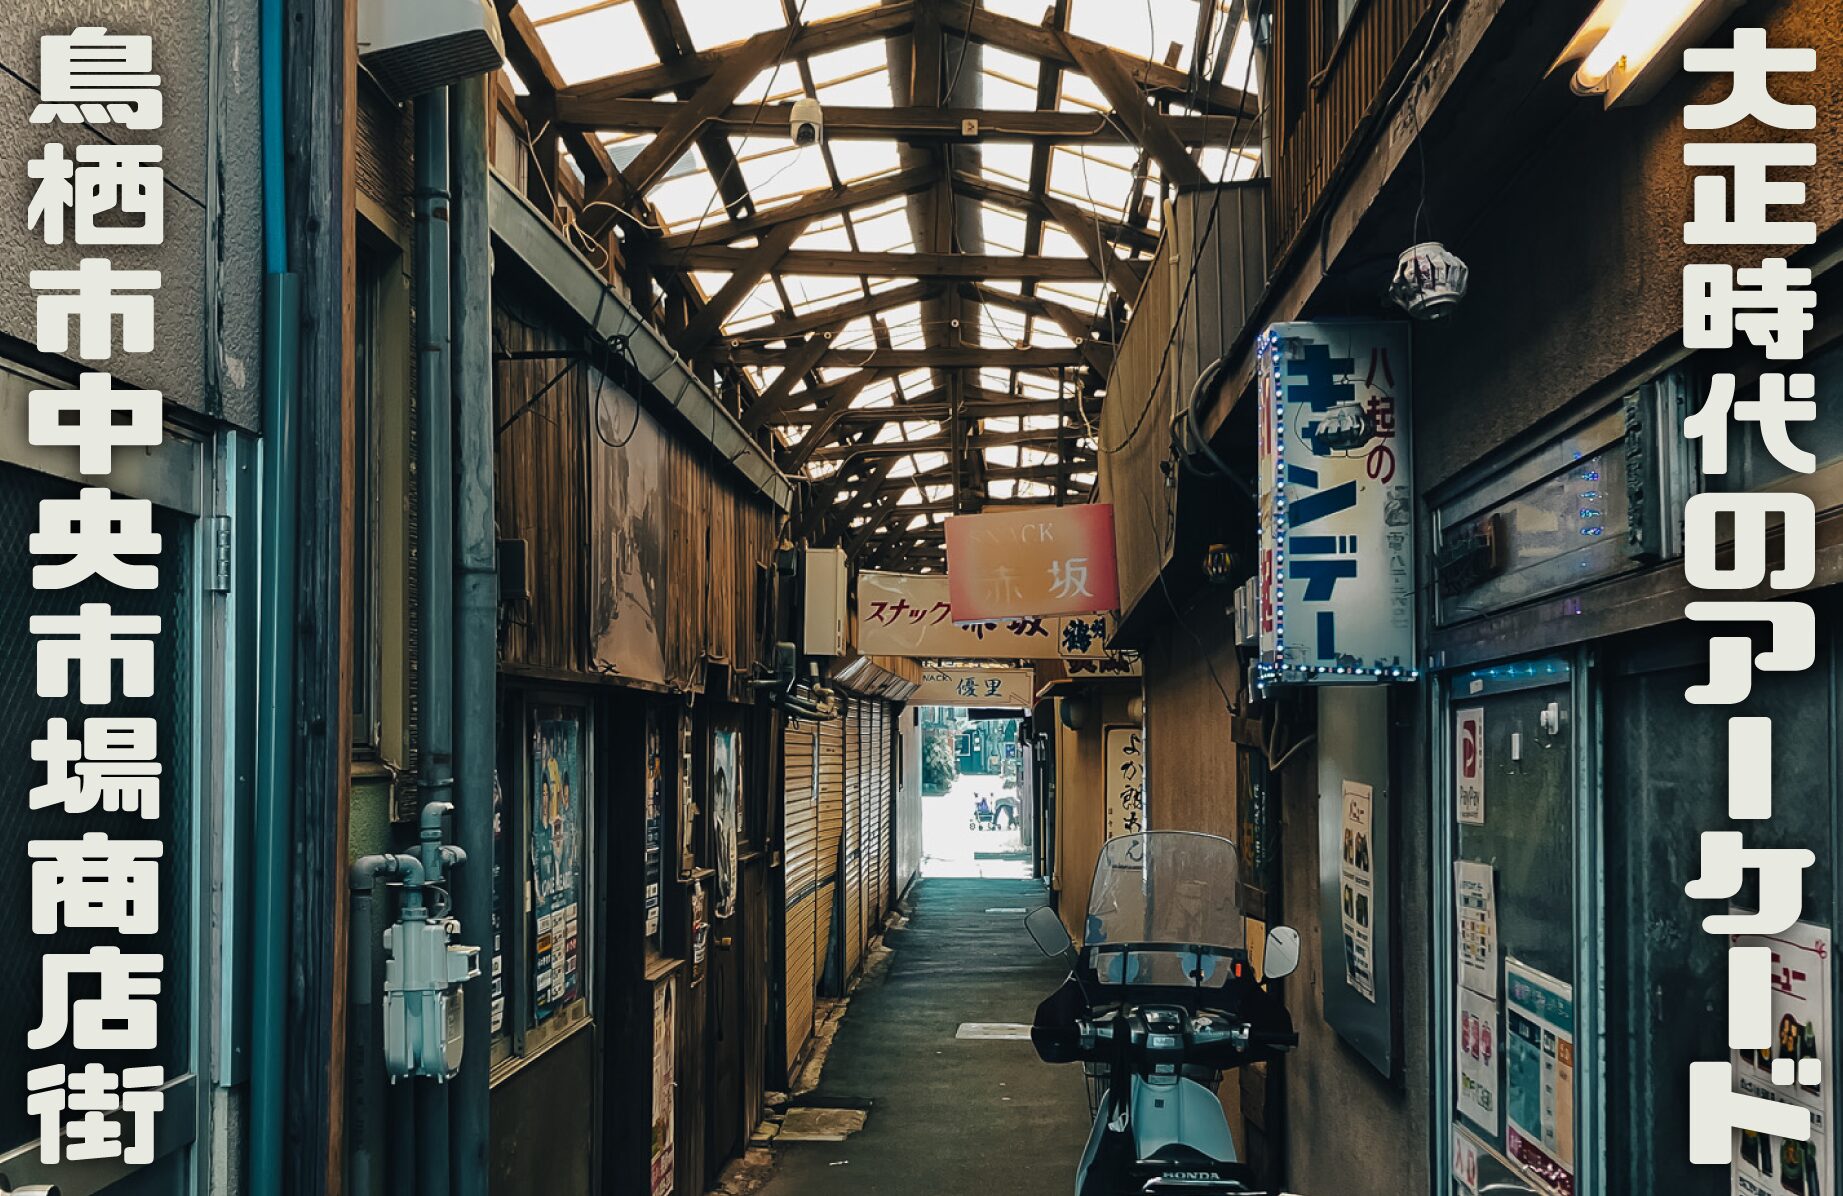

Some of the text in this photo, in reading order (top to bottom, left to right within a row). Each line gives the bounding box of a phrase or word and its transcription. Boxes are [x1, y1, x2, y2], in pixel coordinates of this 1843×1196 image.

[977, 556, 1095, 602] 赤坂
[864, 598, 952, 627] スナック
[956, 676, 1002, 698] 優里
[1163, 1171, 1221, 1181] HONDA
